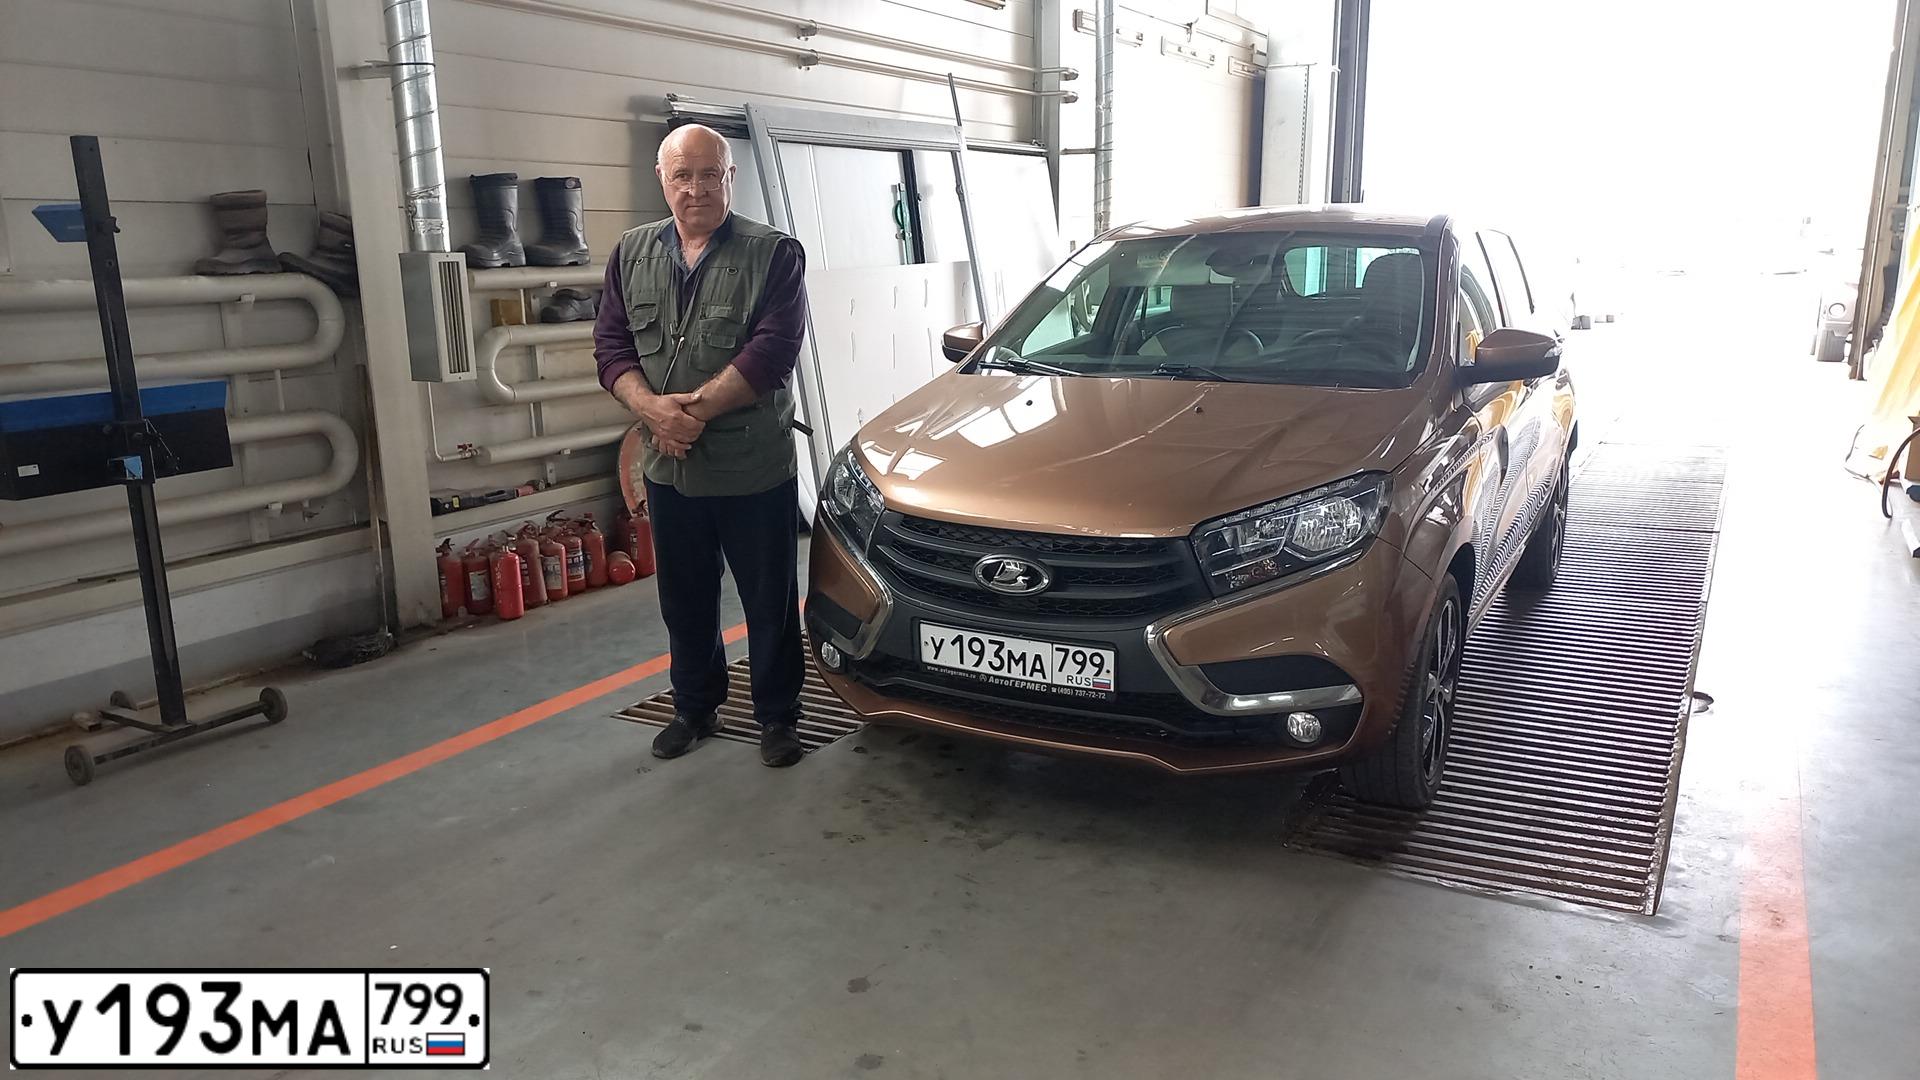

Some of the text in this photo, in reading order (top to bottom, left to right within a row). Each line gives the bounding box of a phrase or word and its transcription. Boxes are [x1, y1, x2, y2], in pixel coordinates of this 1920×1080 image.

[930, 634, 1105, 680] У193МА 799
[988, 675, 1048, 693] АвтоГЕРМЕС
[1066, 674, 1092, 687] RUS
[1075, 688, 1107, 700] 737-72-72
